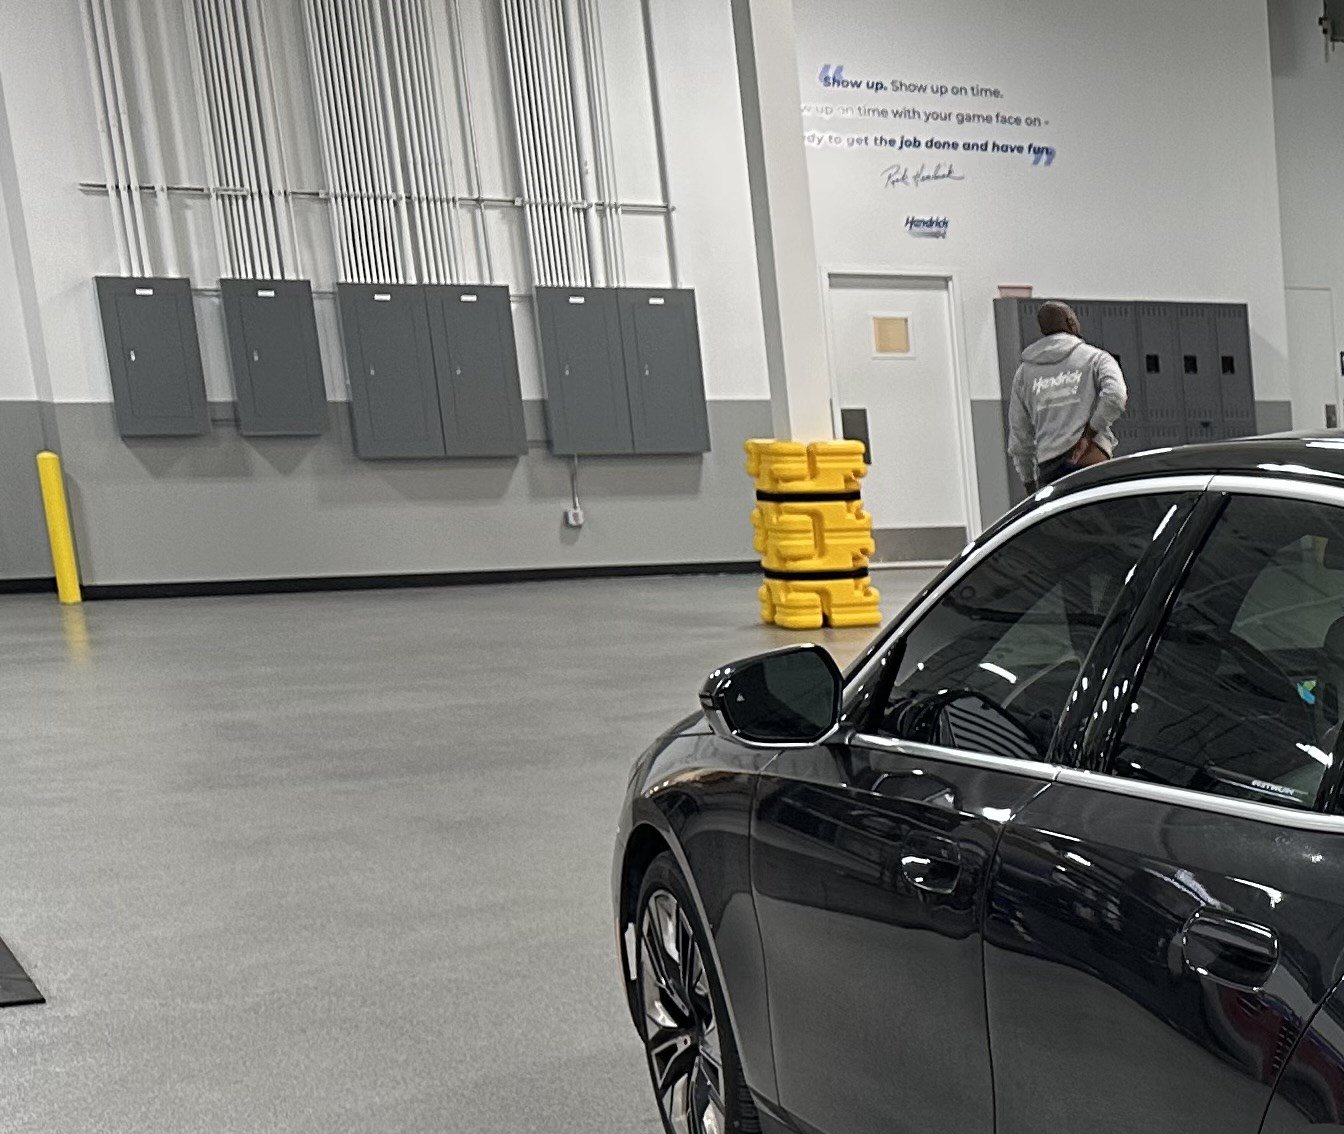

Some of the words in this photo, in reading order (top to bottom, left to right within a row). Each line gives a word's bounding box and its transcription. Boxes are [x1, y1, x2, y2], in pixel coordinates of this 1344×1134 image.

[866, 80, 888, 93] up.
[890, 79, 929, 93] Show
[930, 84, 949, 98] up
[951, 85, 968, 96] on
[970, 84, 1004, 98] time.
[857, 105, 889, 118] time
[891, 107, 921, 119] with
[923, 110, 953, 123] your
[955, 111, 993, 125] game
[996, 112, 1022, 126] face
[1025, 116, 1042, 127] on
[828, 134, 842, 144] to
[846, 136, 869, 147] get
[874, 135, 897, 147] the
[898, 135, 922, 150] job
[925, 137, 960, 151] done
[962, 140, 989, 152] and
[991, 140, 1025, 154] have
